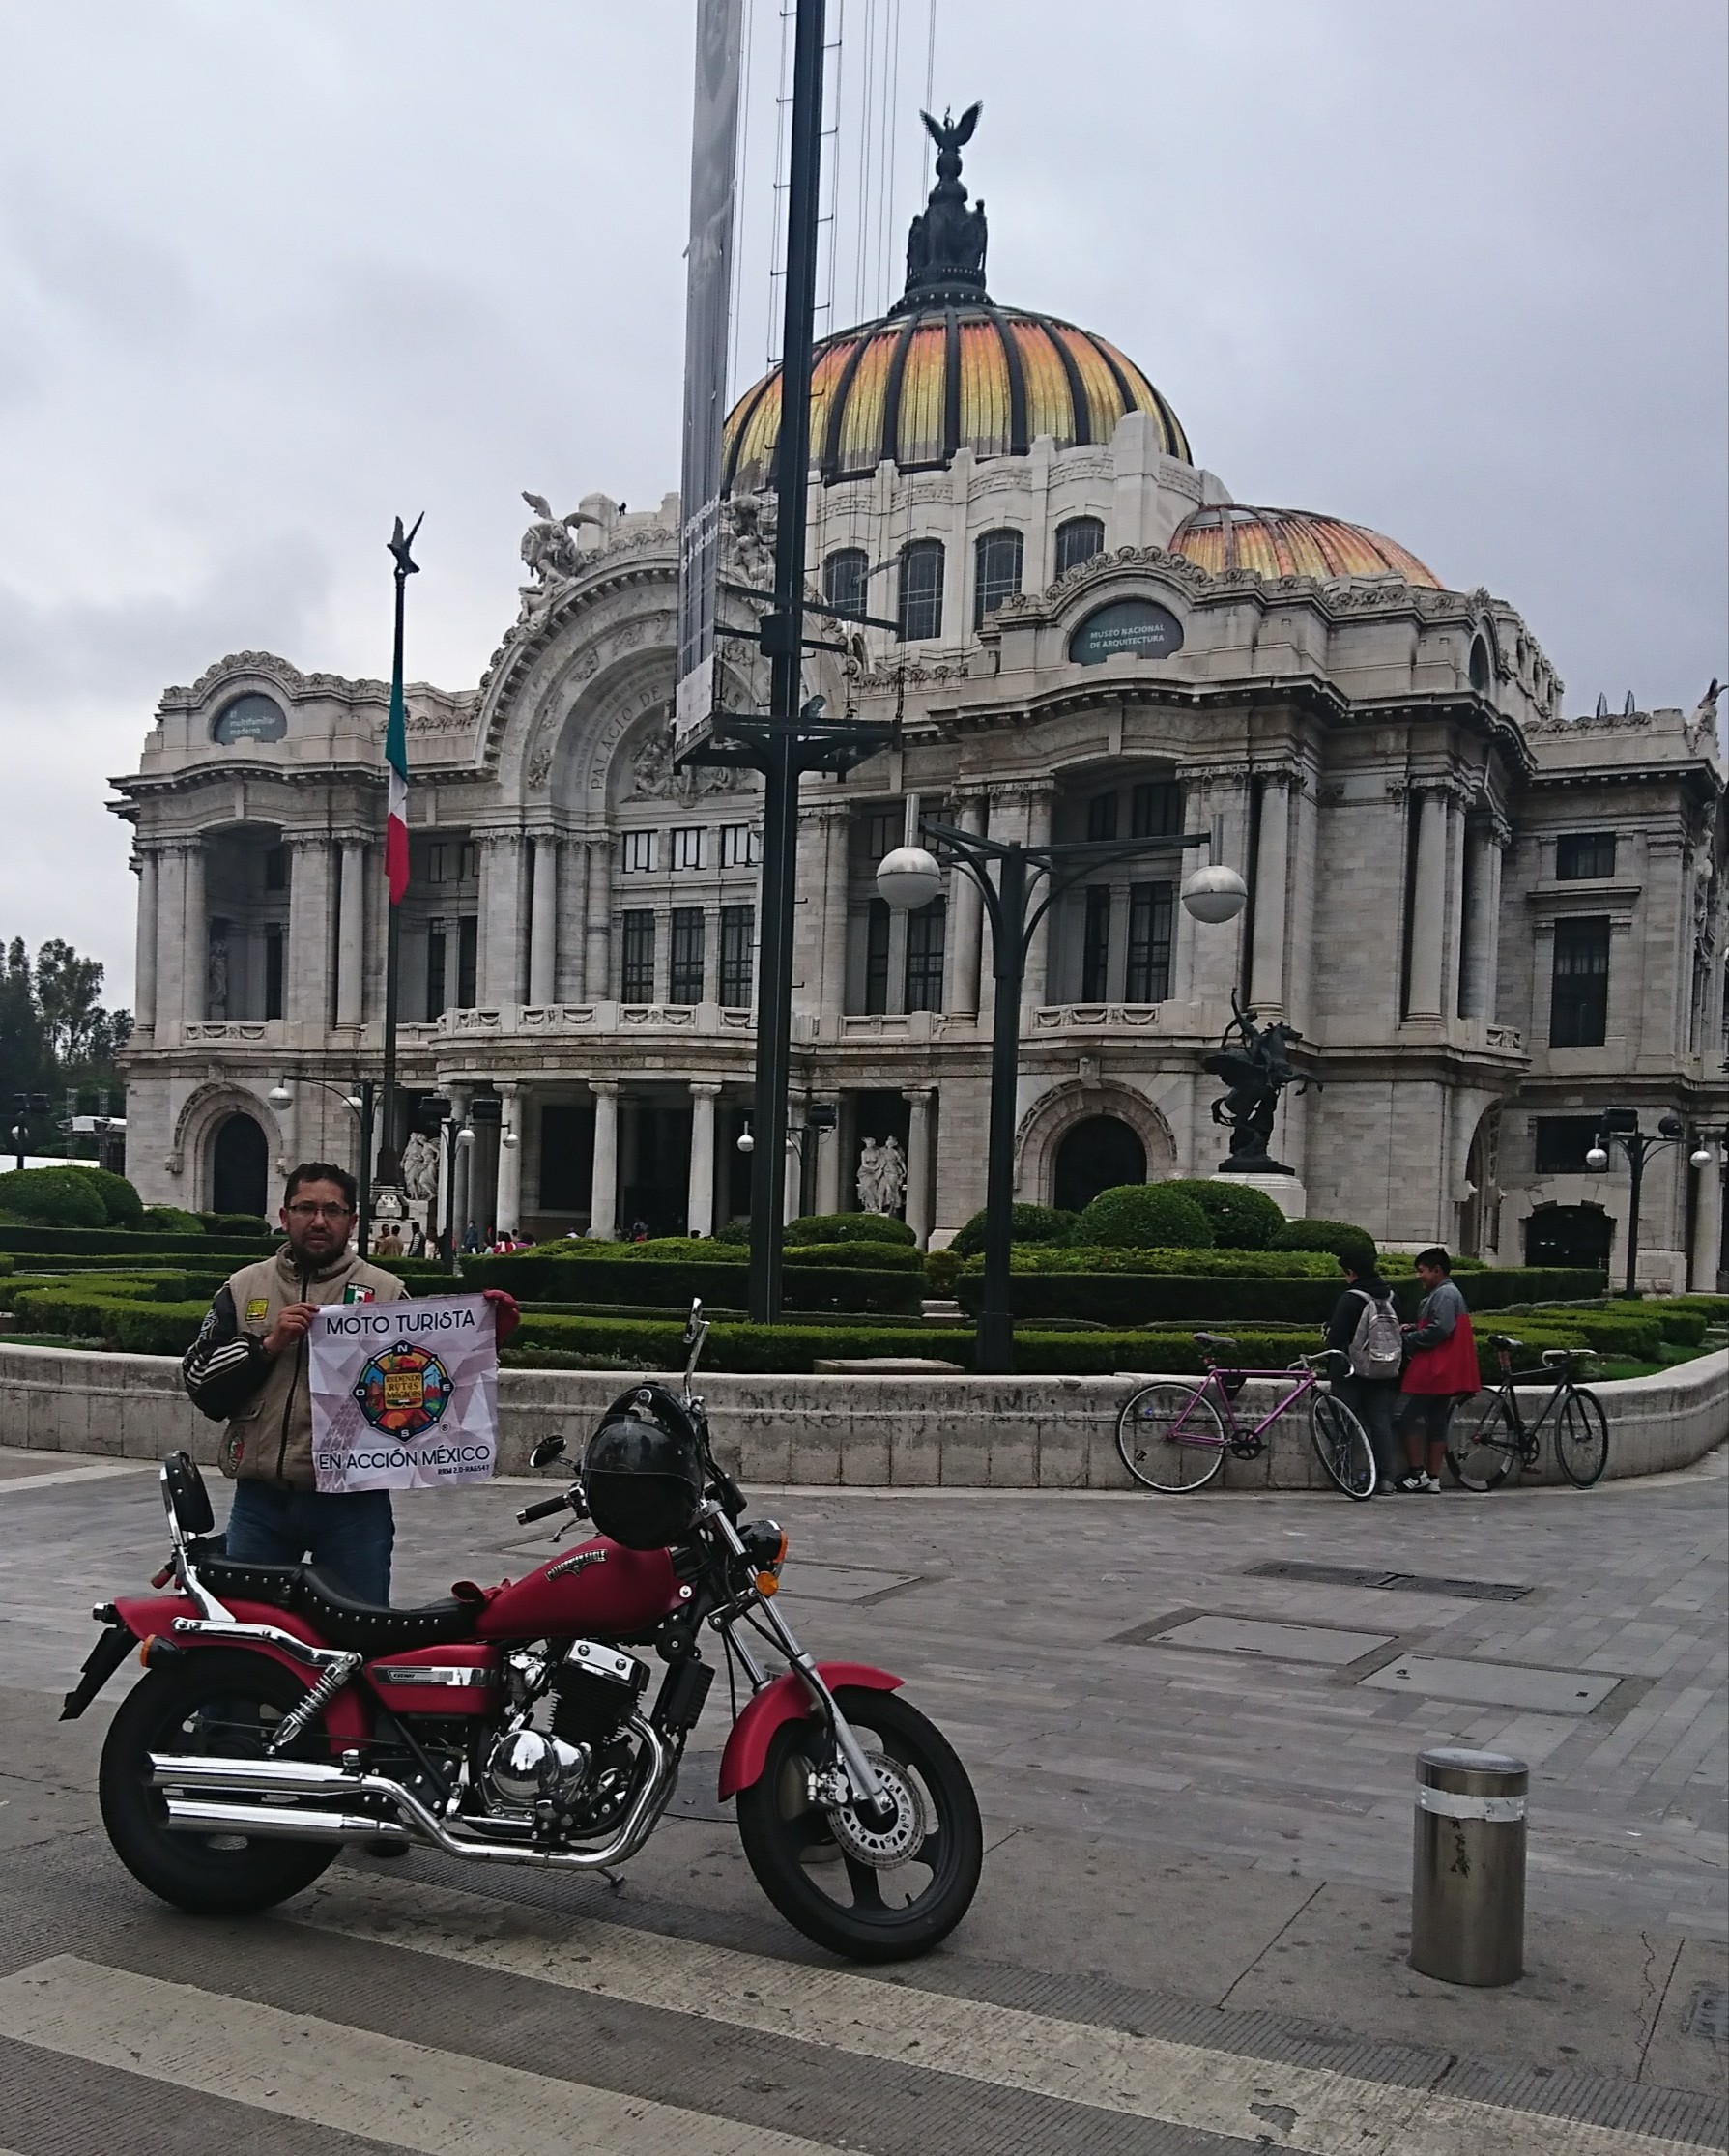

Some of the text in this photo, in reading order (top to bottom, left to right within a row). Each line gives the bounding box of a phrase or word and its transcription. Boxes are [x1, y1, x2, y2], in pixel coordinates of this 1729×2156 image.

[1090, 624, 1165, 639] MUSEO NACIONAL
[1102, 634, 1165, 648] ARQUITECTURA
[591, 685, 663, 790] PALACIO DE
[327, 1309, 475, 1335] MOTO TURISTA
[319, 1445, 490, 1470] EN ACCIÓN MÉXICO
